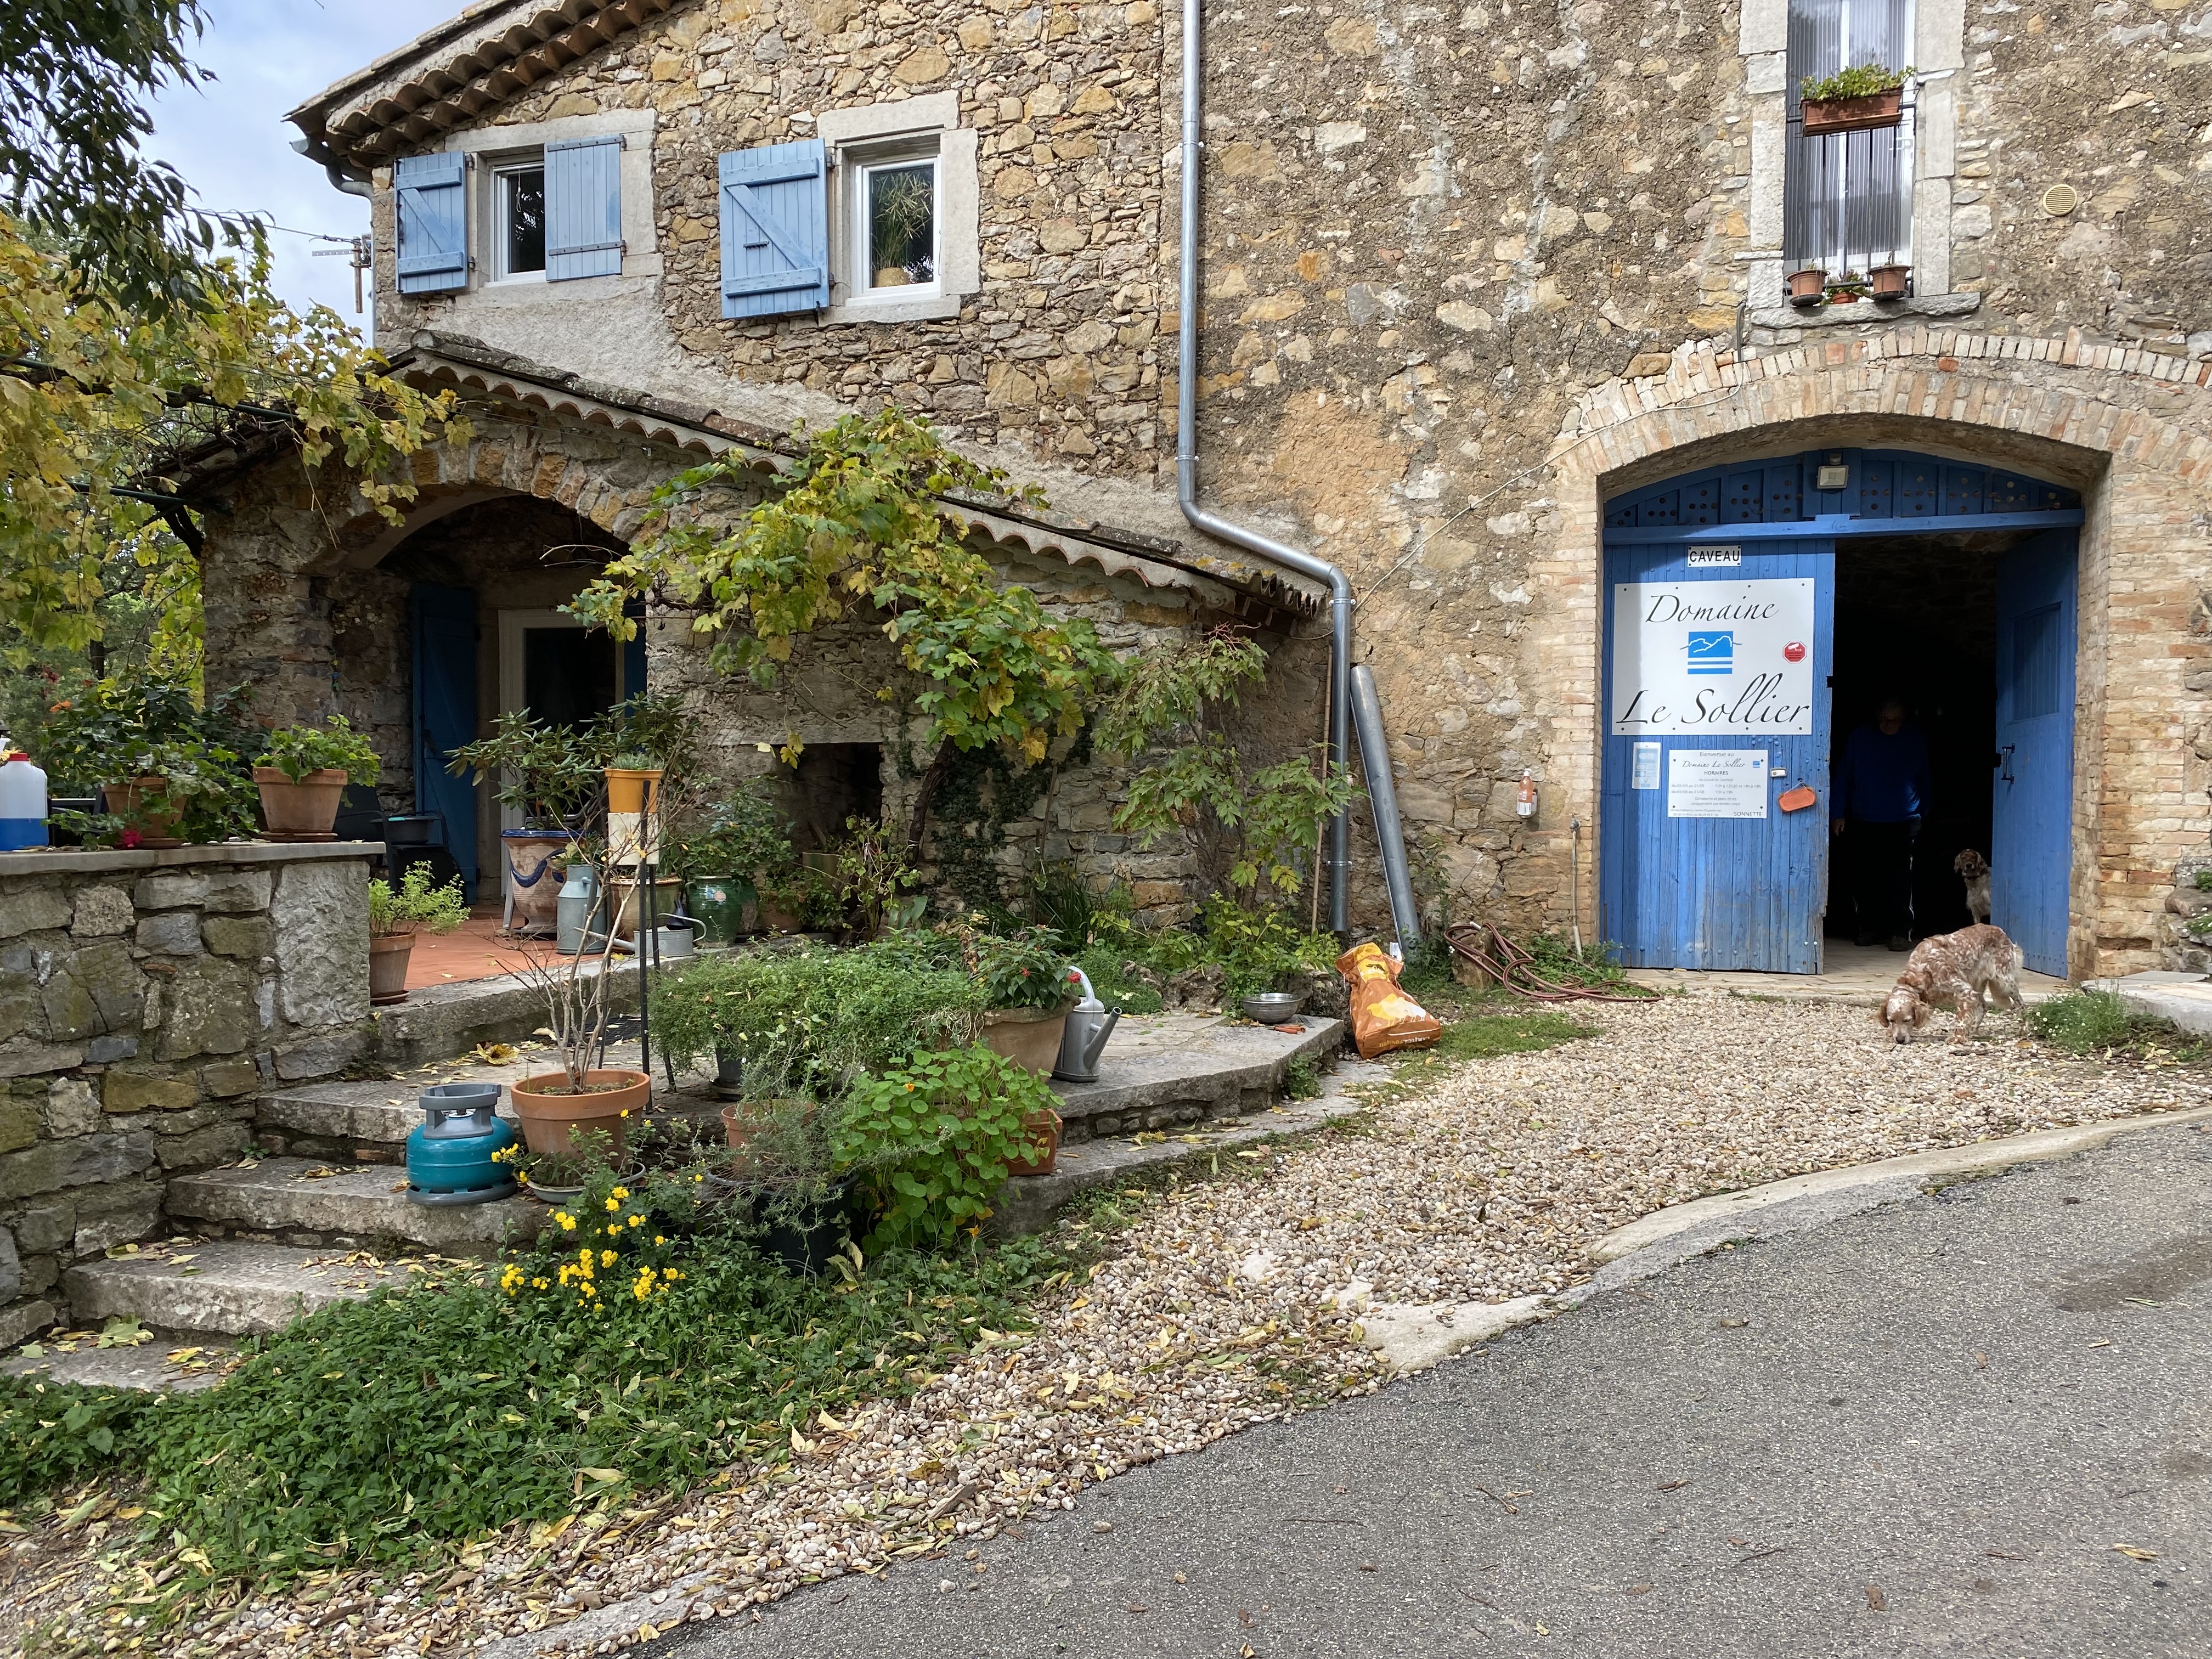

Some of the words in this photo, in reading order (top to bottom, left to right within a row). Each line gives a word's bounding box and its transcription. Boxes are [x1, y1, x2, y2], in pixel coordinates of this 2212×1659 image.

[1690, 550, 1740, 562] CAVEAU
[1646, 595, 1779, 623] Domaine
[1615, 690, 1672, 724] Le
[1681, 673, 1810, 724] Sollier
[1723, 758, 1745, 768] Sollier
